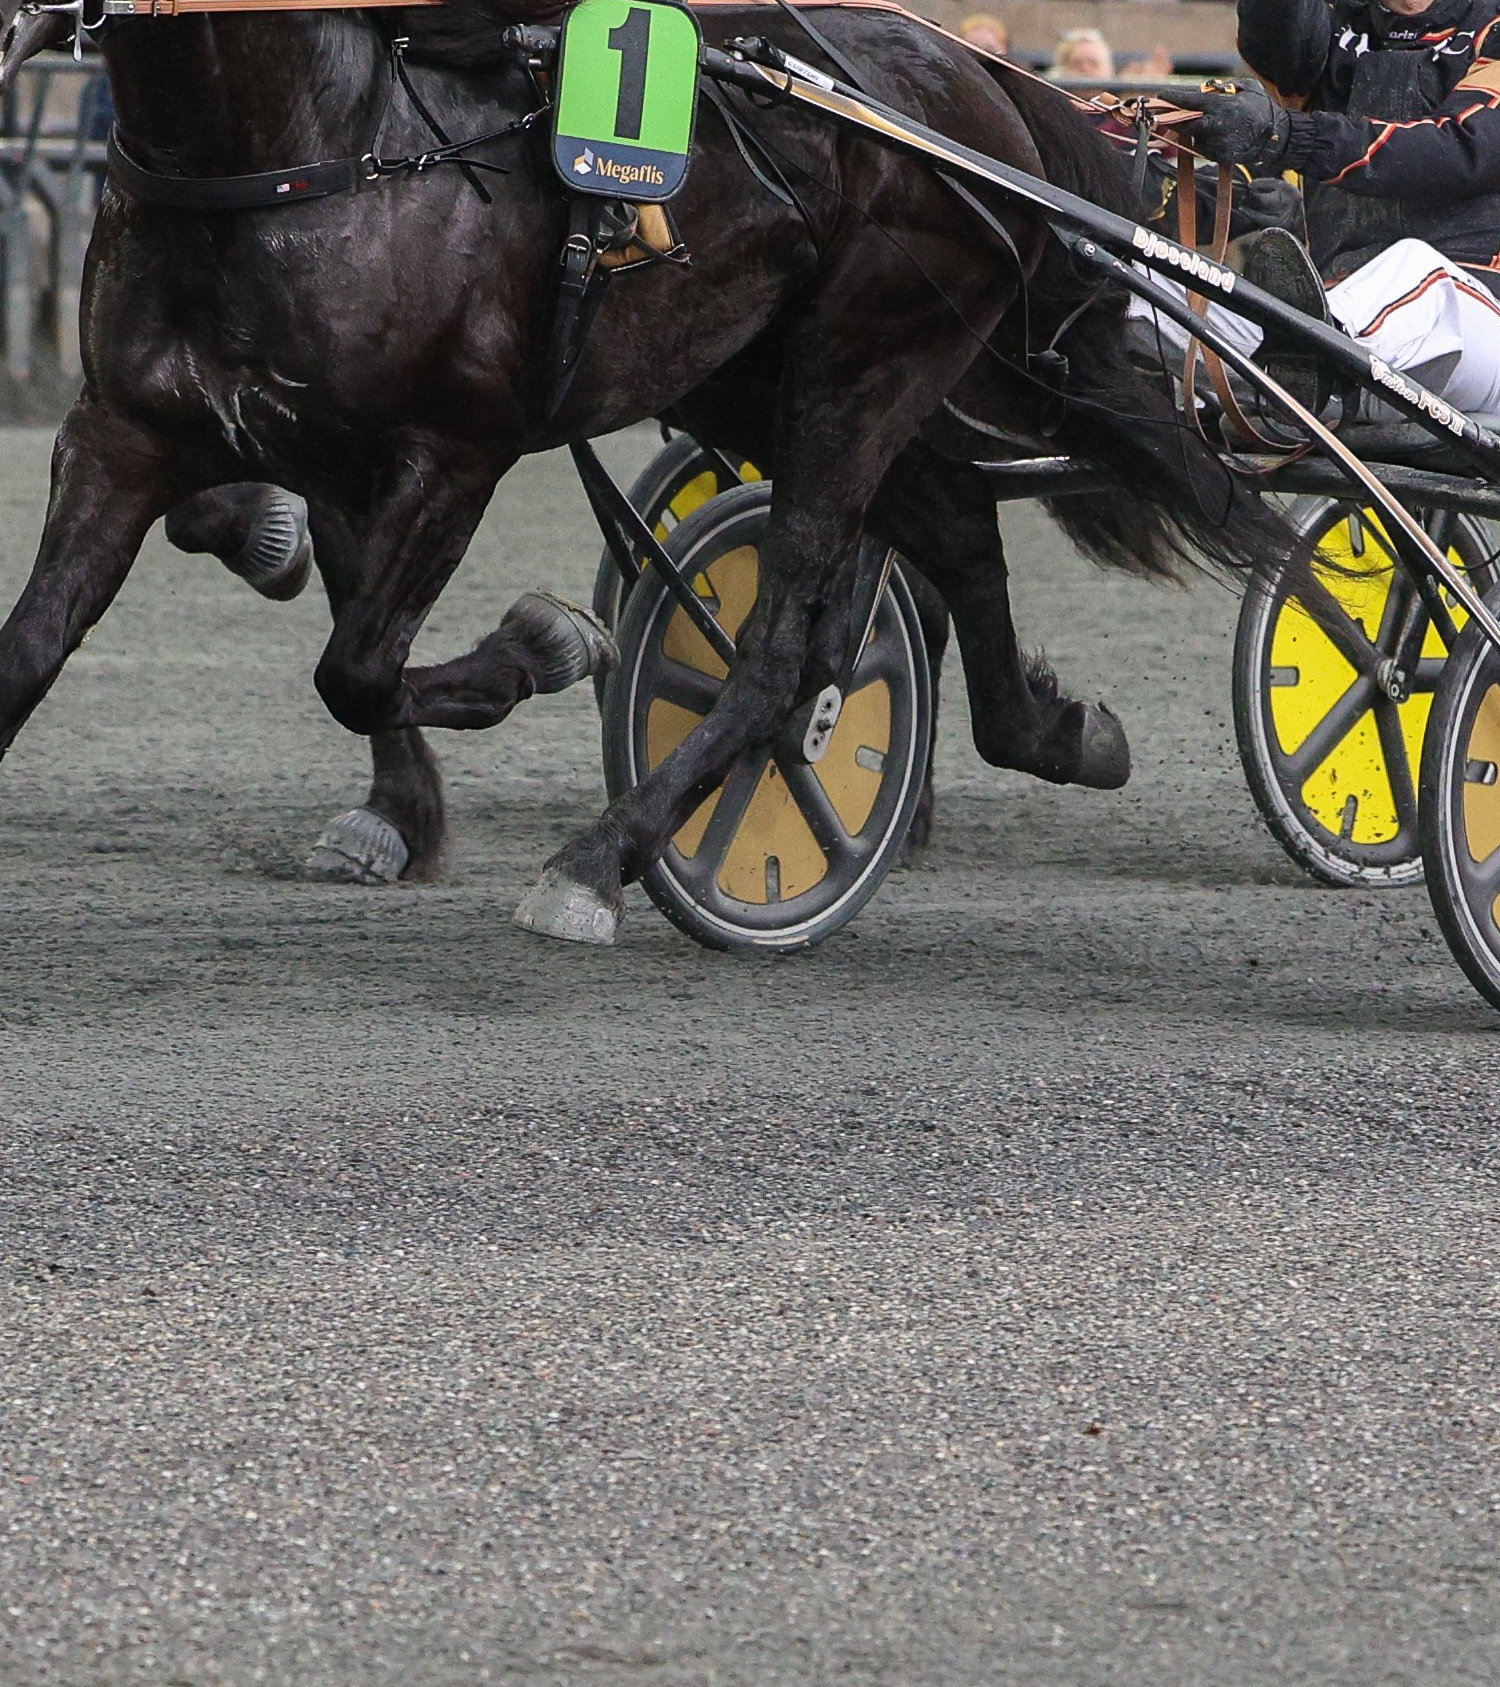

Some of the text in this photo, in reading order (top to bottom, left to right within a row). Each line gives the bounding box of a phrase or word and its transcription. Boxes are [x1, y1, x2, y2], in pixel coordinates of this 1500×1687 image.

[607, 6, 652, 140] 1
[595, 156, 664, 185] Megaflis
[1418, 389, 1452, 425] FCS
